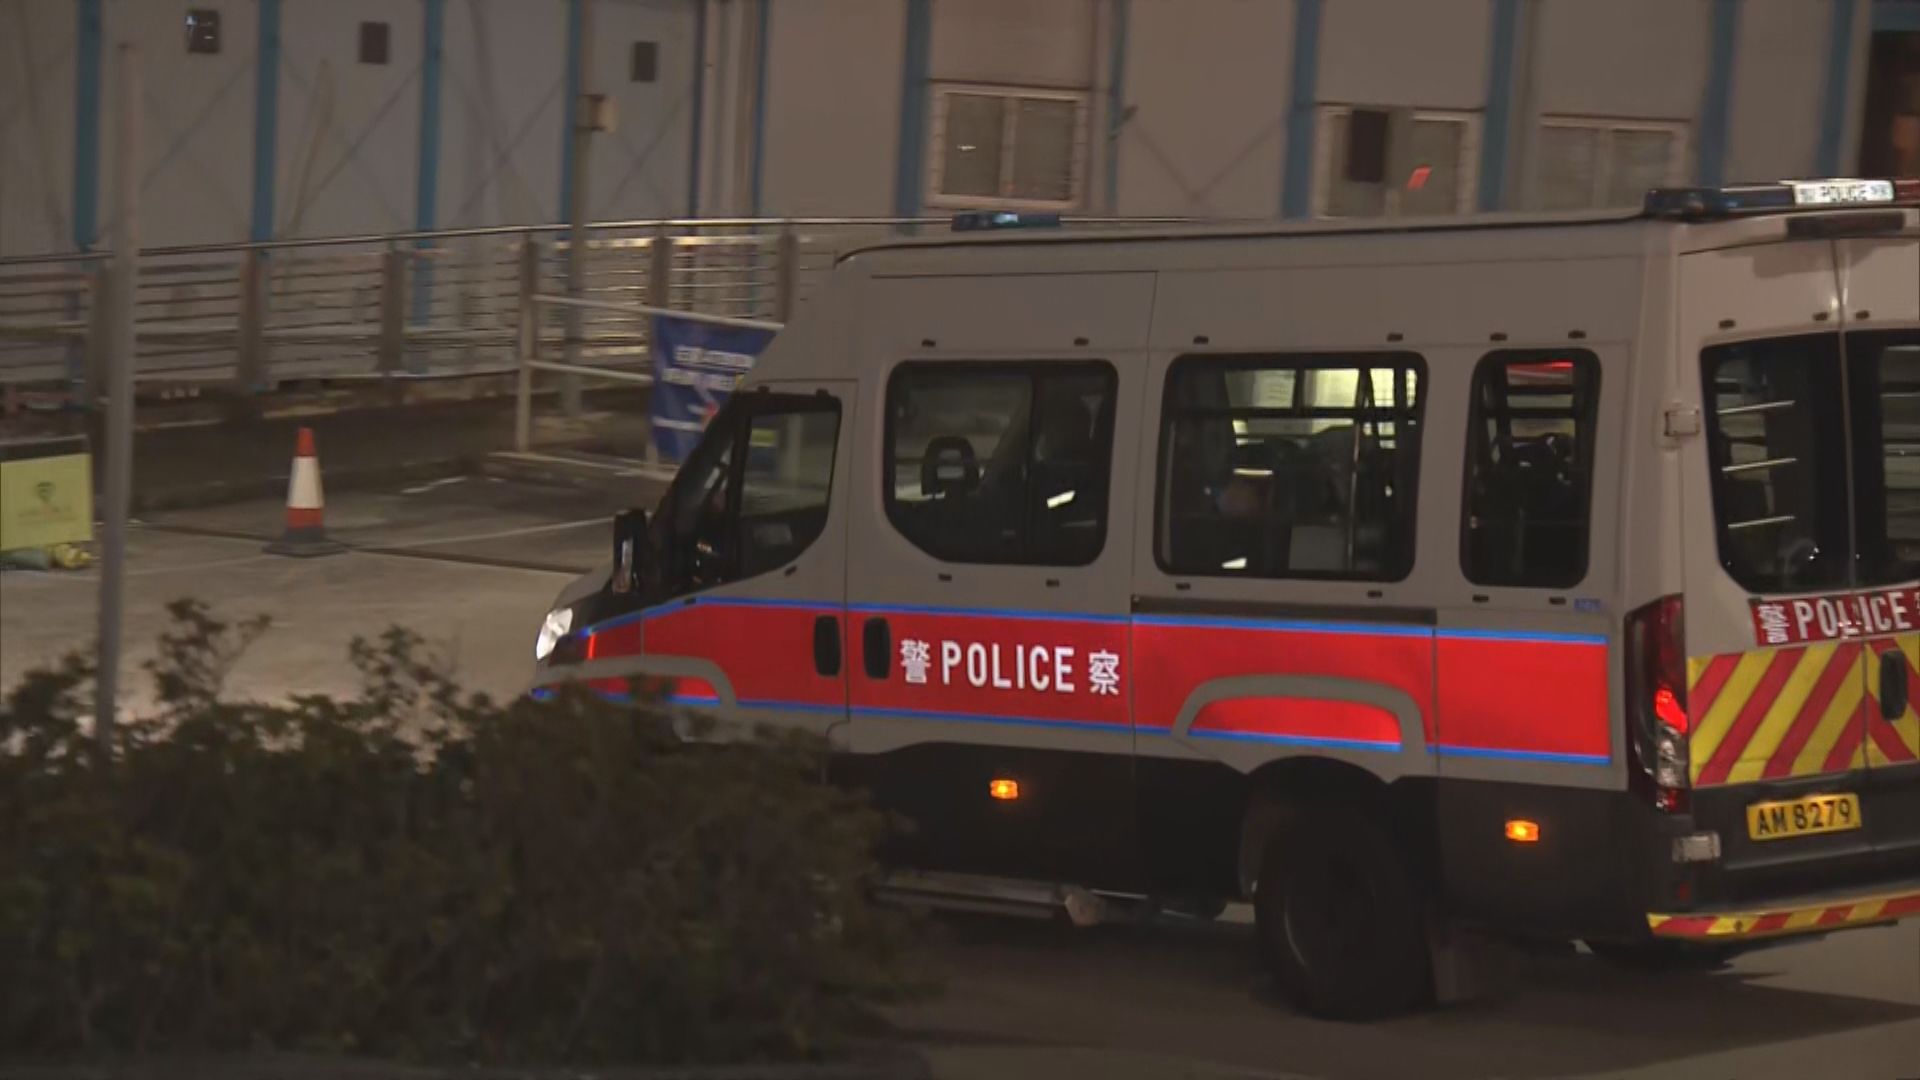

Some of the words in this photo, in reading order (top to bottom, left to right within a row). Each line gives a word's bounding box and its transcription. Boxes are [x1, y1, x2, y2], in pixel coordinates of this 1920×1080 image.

[1820, 185, 1867, 201] POLICE
[1792, 592, 1912, 640] POLICE
[900, 639, 931, 684] 警
[941, 640, 1075, 693] POLICE
[1088, 650, 1120, 695] 察
[1758, 807, 1788, 835] AM
[1794, 798, 1851, 829] 8279
